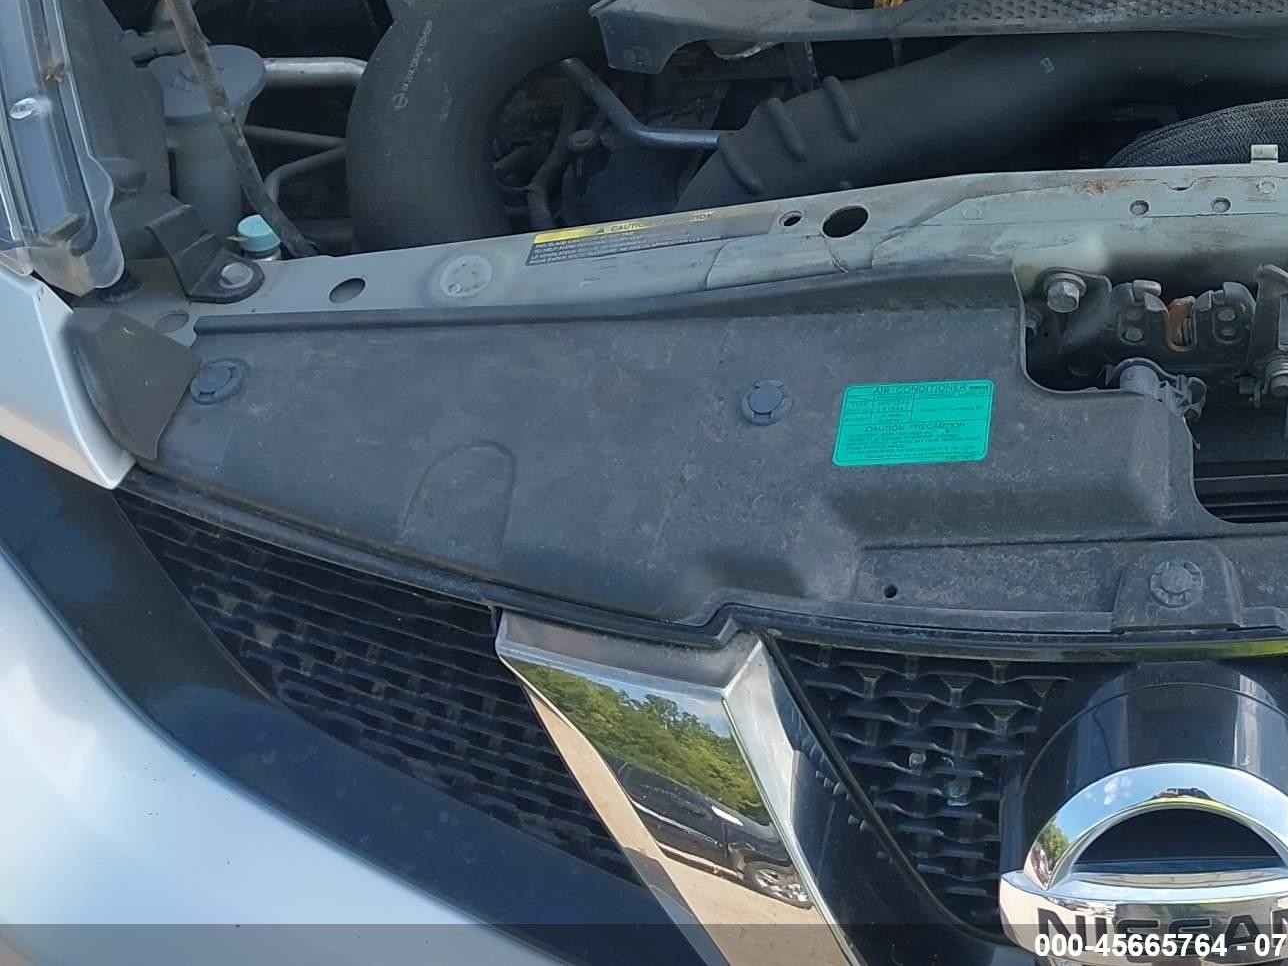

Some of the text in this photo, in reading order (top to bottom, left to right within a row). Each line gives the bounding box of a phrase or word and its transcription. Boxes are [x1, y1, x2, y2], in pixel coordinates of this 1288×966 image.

[872, 385, 889, 394] AIR
[895, 383, 966, 395] CONDITIONER
[865, 424, 905, 433] CAUTION
